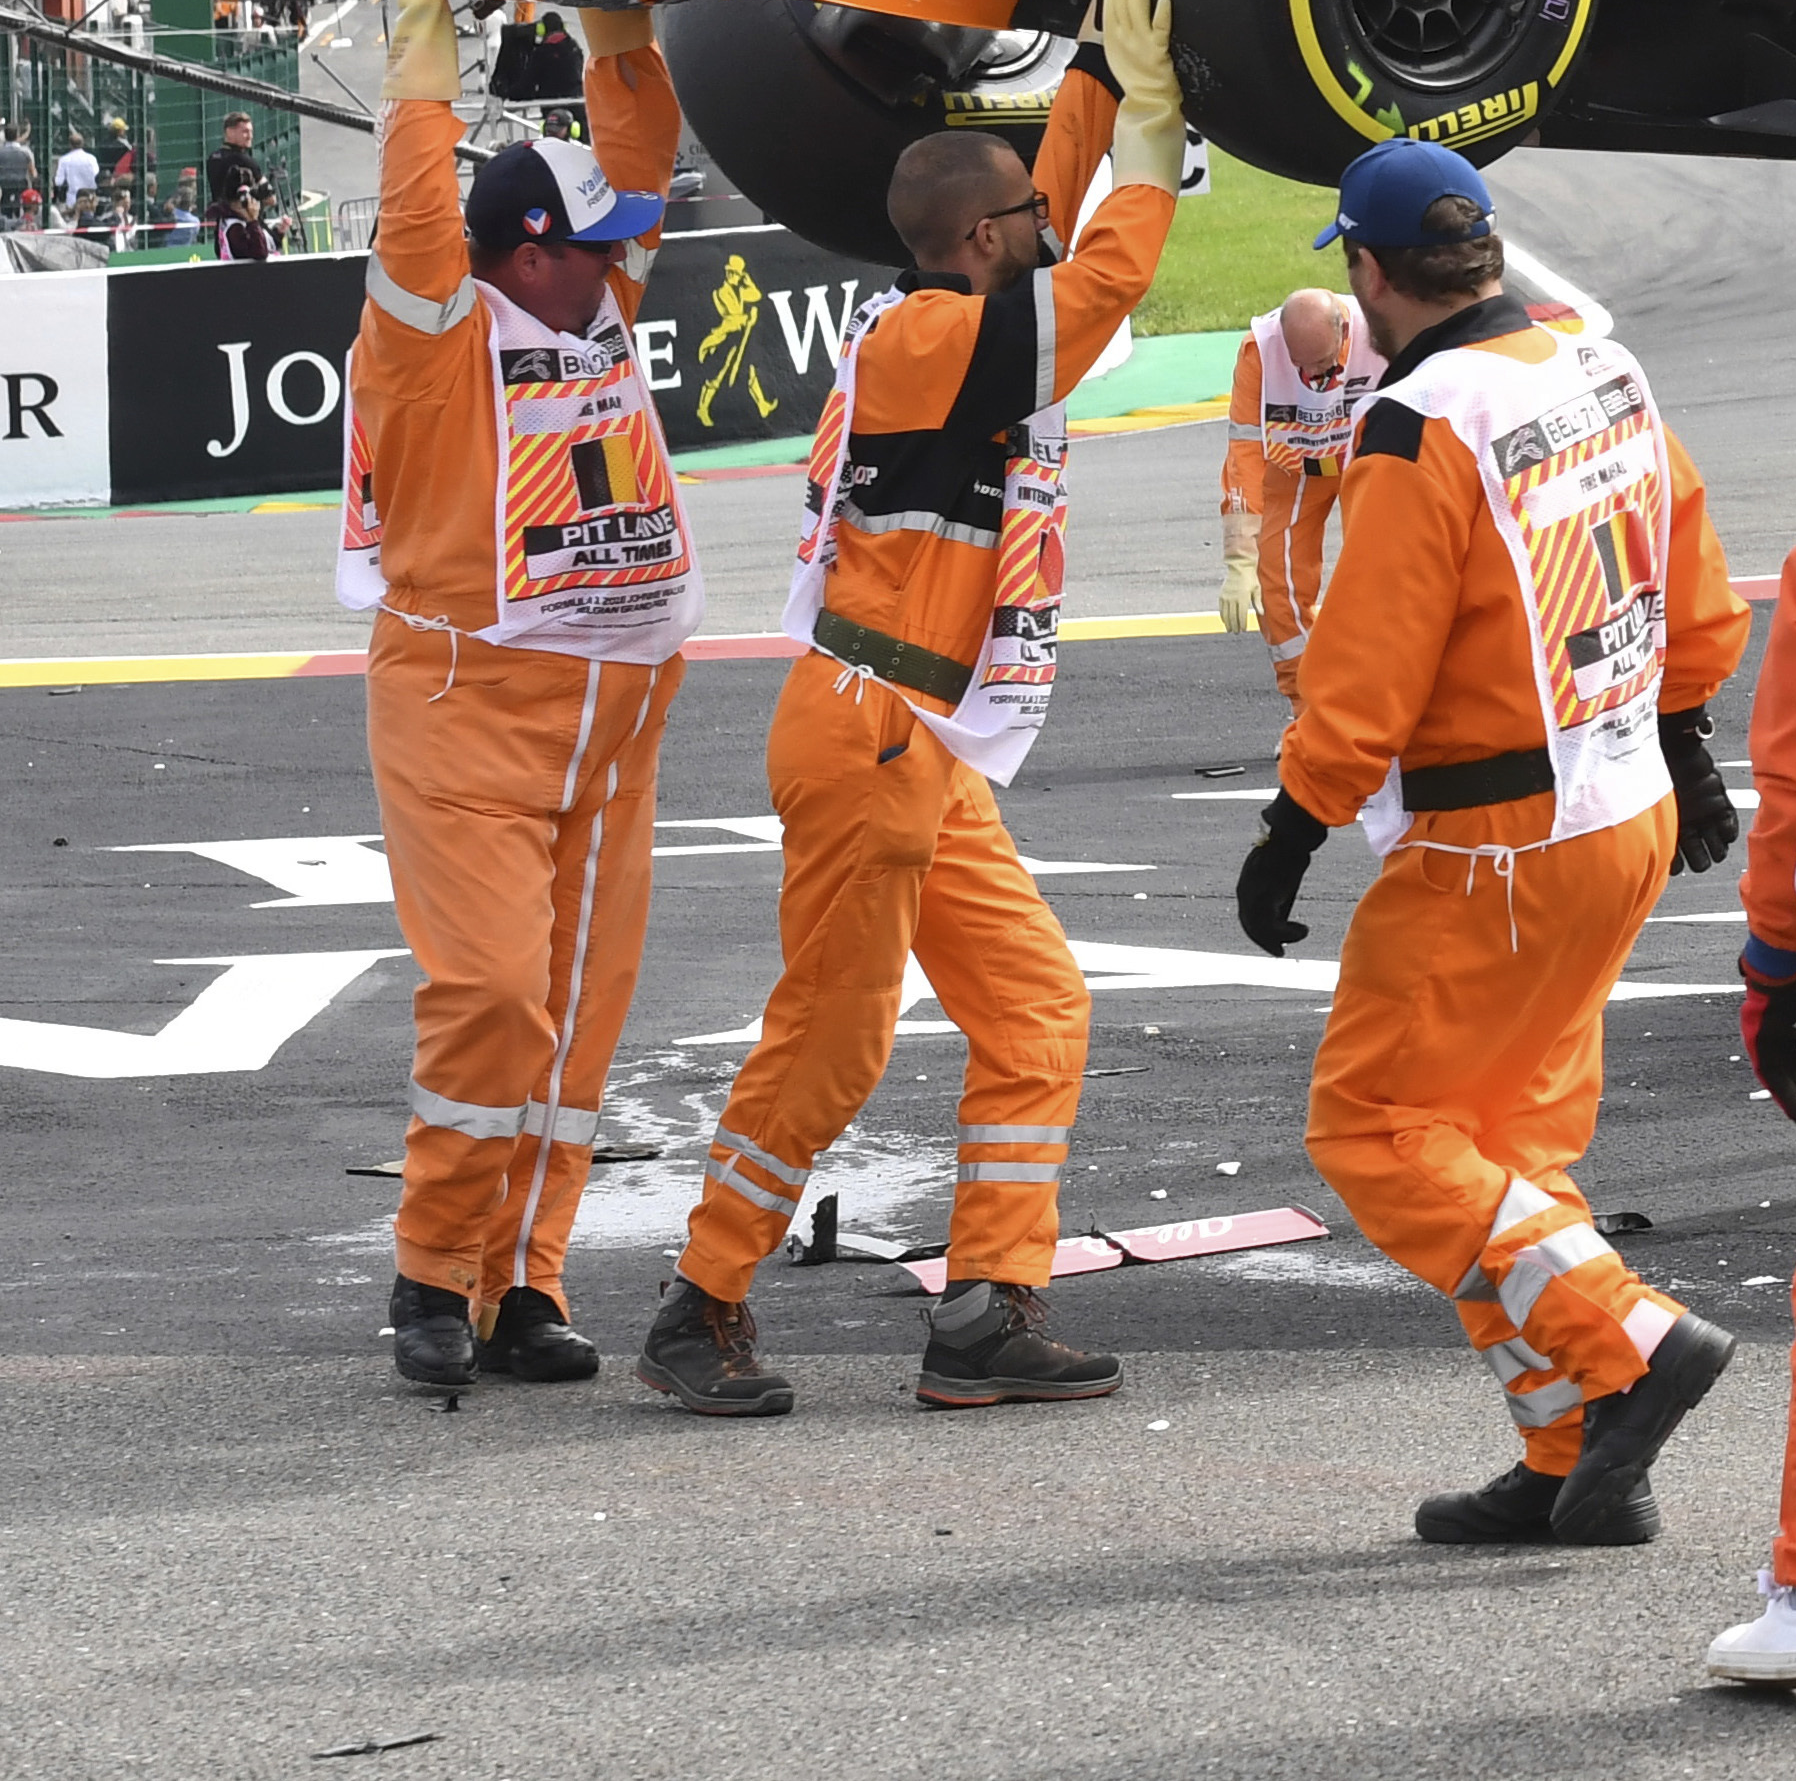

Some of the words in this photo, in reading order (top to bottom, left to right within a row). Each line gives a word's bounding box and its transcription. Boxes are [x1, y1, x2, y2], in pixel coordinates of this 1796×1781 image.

[1407, 80, 1541, 147] PIRELLI
[561, 517, 614, 547] PIT
[572, 546, 619, 568] ALL
[1599, 618, 1629, 655] PIT
